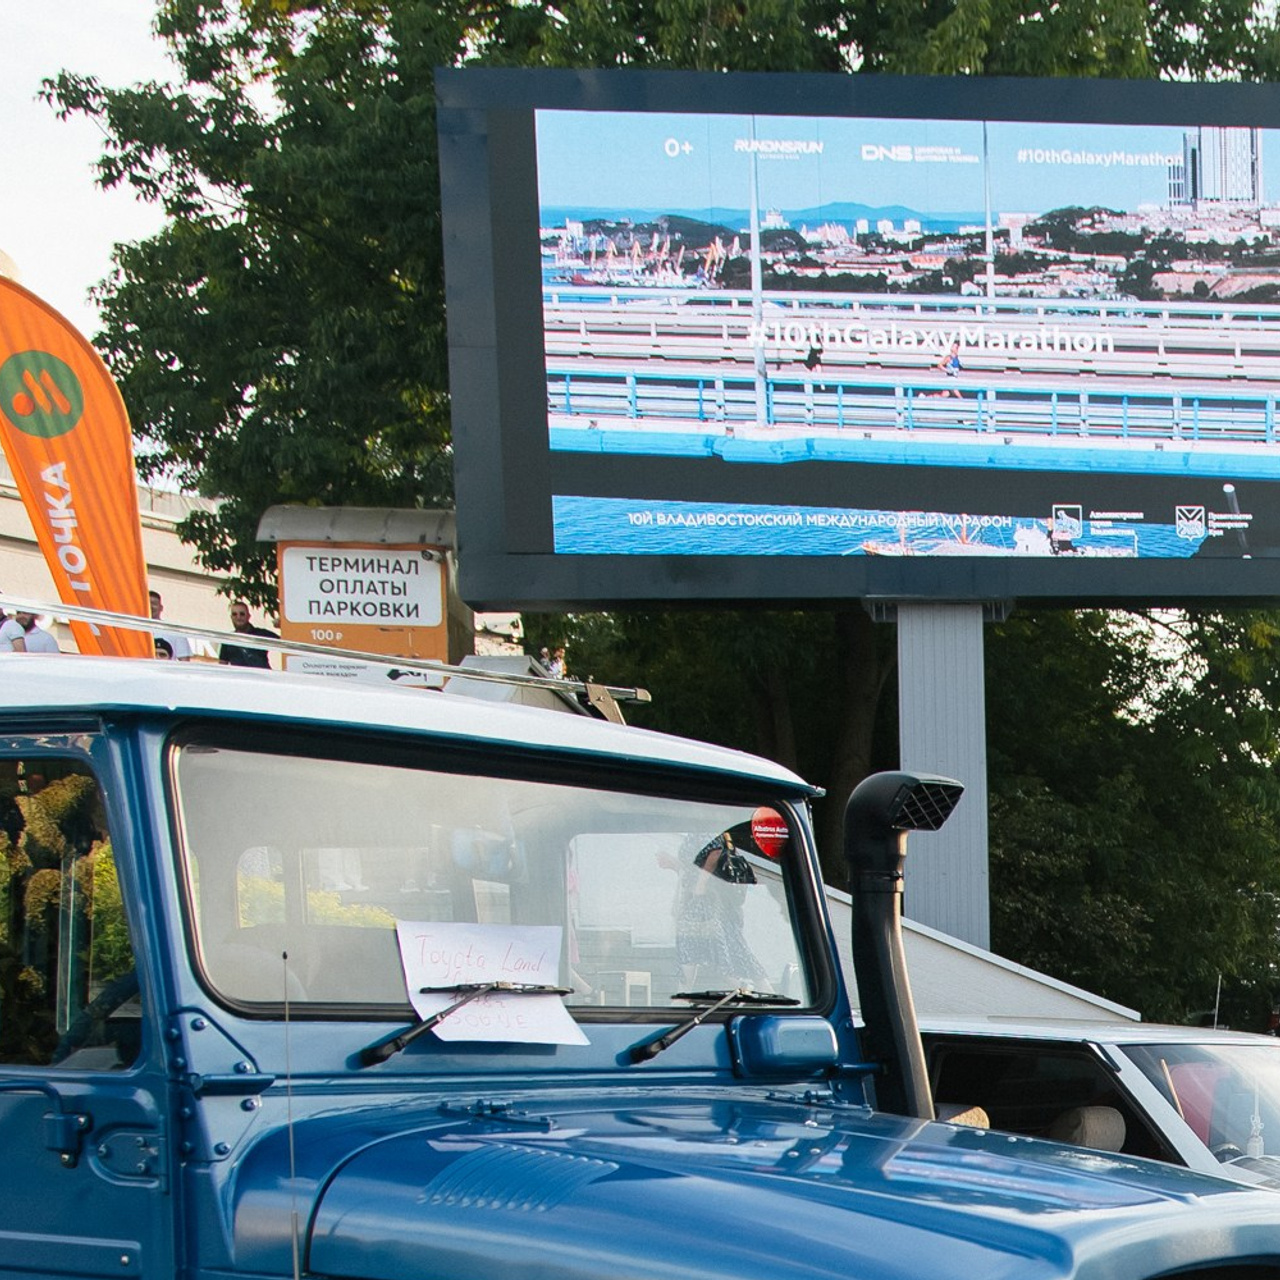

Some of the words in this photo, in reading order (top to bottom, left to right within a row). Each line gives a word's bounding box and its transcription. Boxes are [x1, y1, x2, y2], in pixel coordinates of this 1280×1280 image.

[664, 138, 693, 157] 0+
[861, 145, 912, 161] DNS
[1018, 149, 1183, 167] #10thGalaxyMarathon
[746, 320, 1115, 356] #10thGalaxyMarathon
[657, 512, 803, 528] ВЛАДИВОСТОКСКИЙ
[807, 513, 938, 529] МЕЖДУНАРОДНЫЙ
[942, 515, 1012, 529] МАРАФОН
[306, 556, 419, 575] ТЕРМИНАЛ
[319, 579, 407, 596] ОПЛАТЫ
[308, 600, 419, 618] ПАРКОВКИ
[415, 934, 486, 979] Toyota
[503, 942, 546, 973] Land
